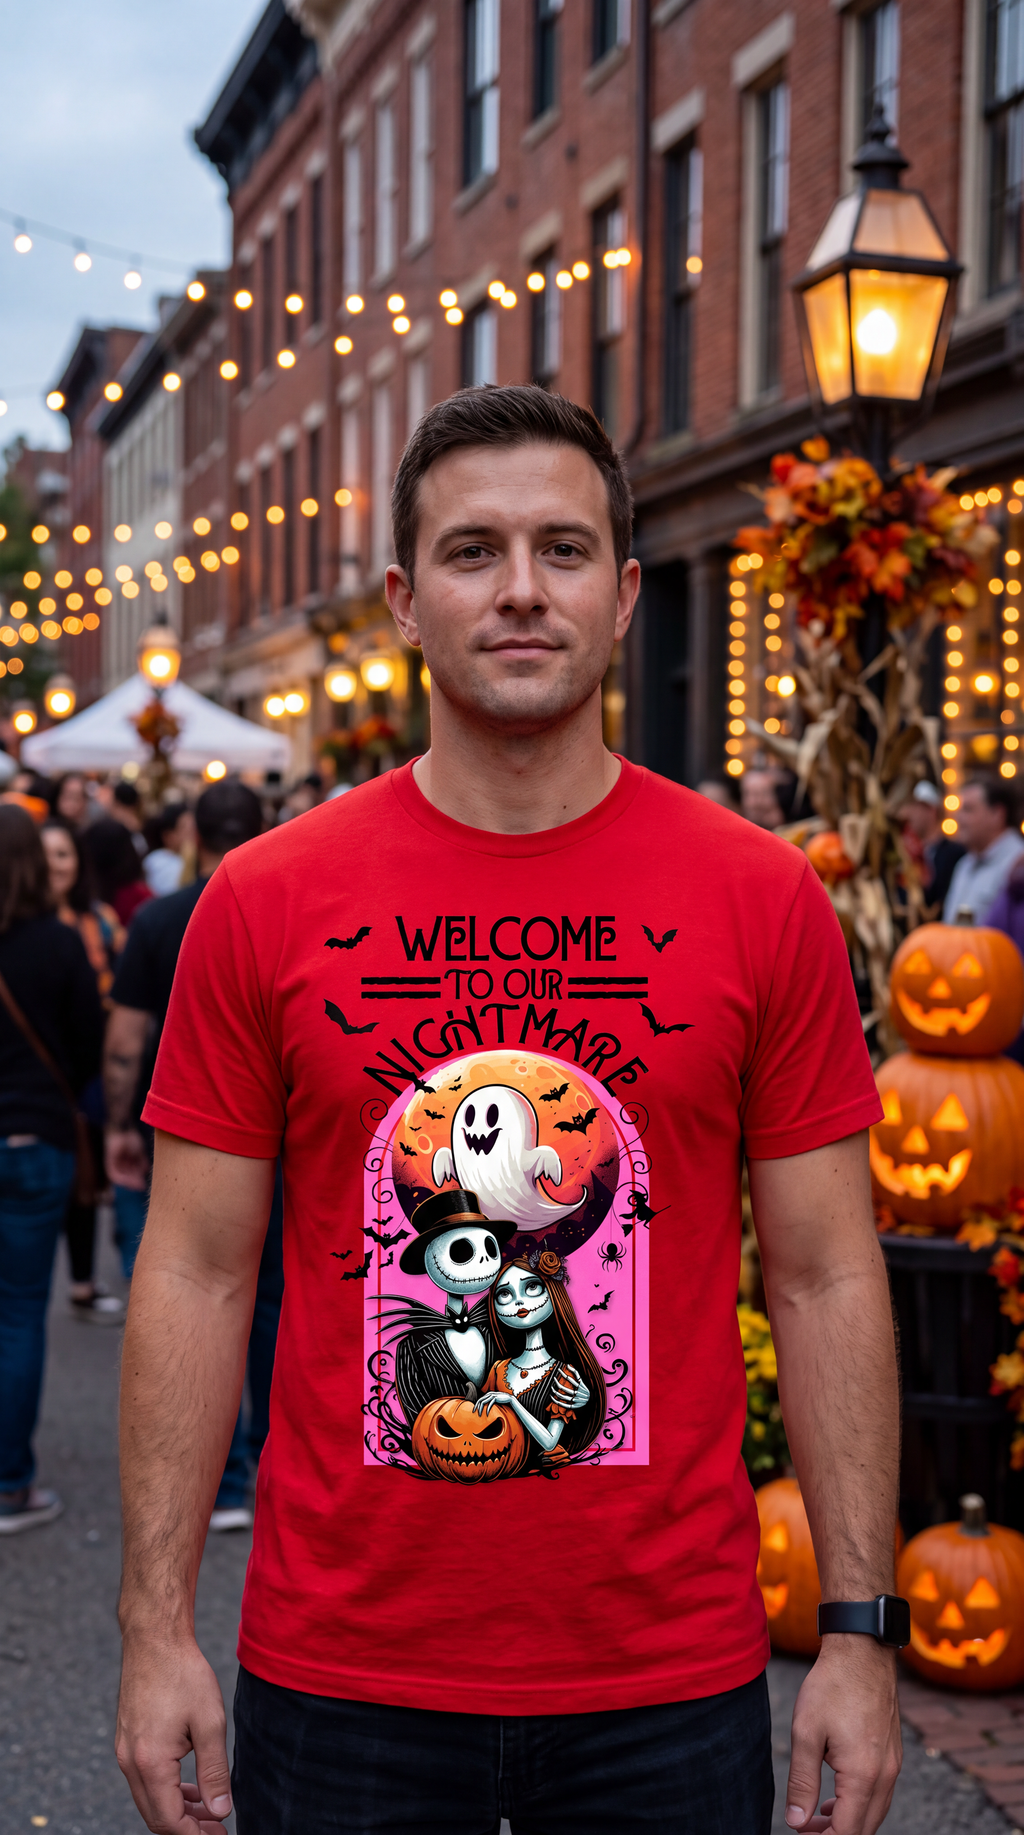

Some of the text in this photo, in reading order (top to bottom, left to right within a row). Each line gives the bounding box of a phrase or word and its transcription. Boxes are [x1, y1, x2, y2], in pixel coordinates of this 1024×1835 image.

[394, 915, 617, 962] WELCOME
[443, 968, 563, 1001] TO OUR
[362, 1003, 650, 1098] NIGHTMARE
